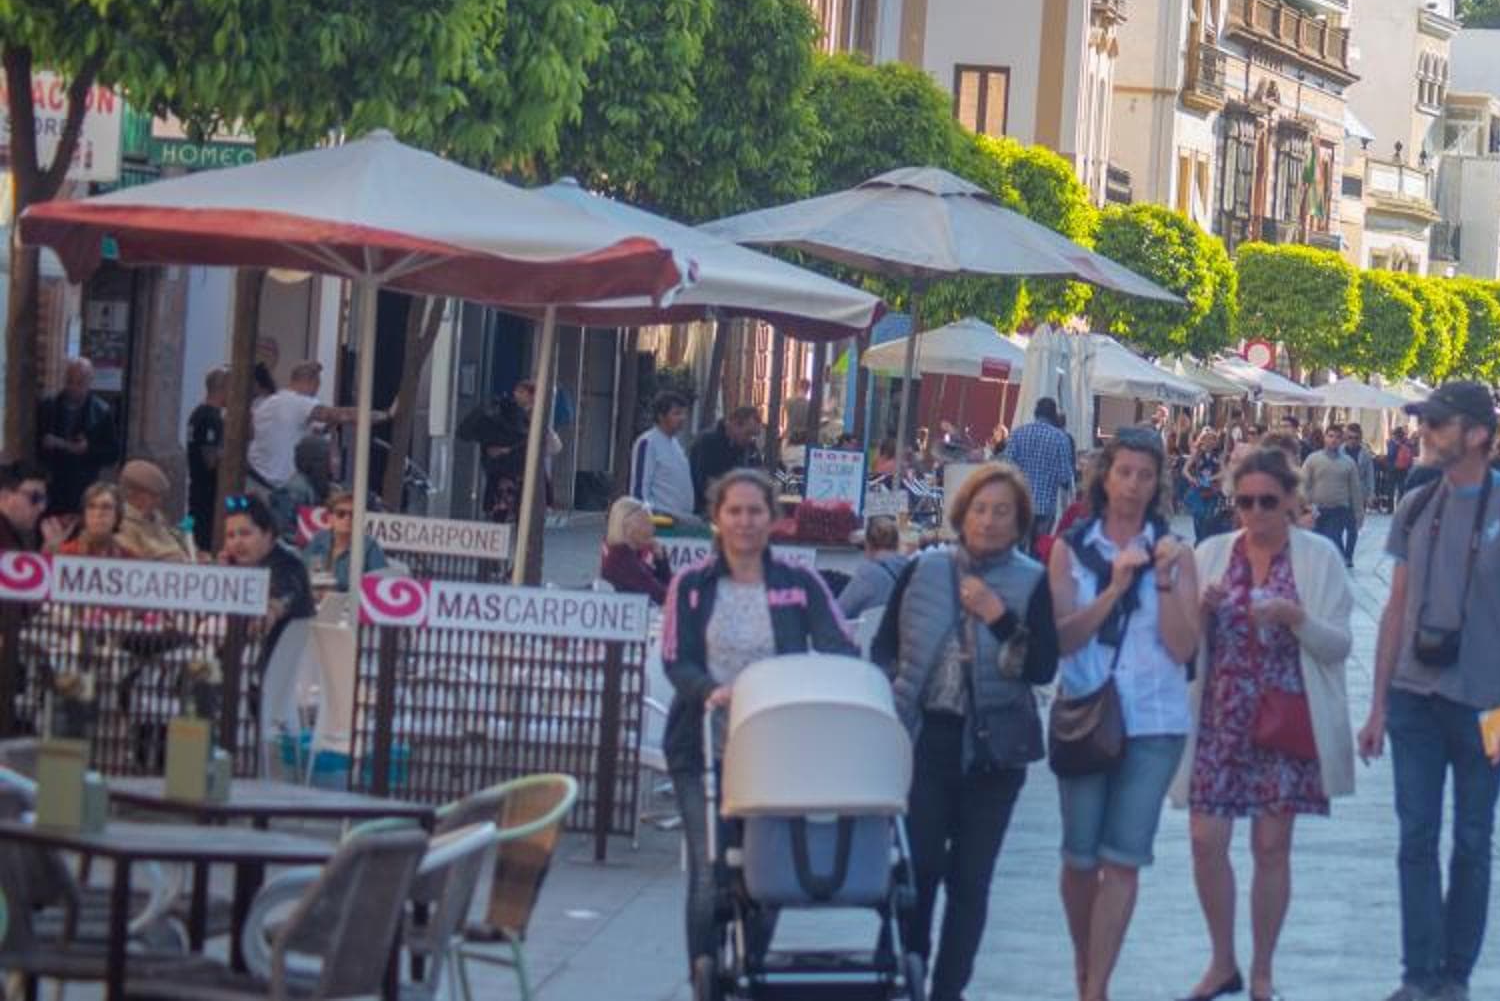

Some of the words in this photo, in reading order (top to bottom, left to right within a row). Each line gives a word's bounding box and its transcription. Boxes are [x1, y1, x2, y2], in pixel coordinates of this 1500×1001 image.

[362, 510, 501, 551] MASCARPONE
[60, 565, 257, 604] MASCARPONE
[436, 592, 634, 631] MASCARPONE
